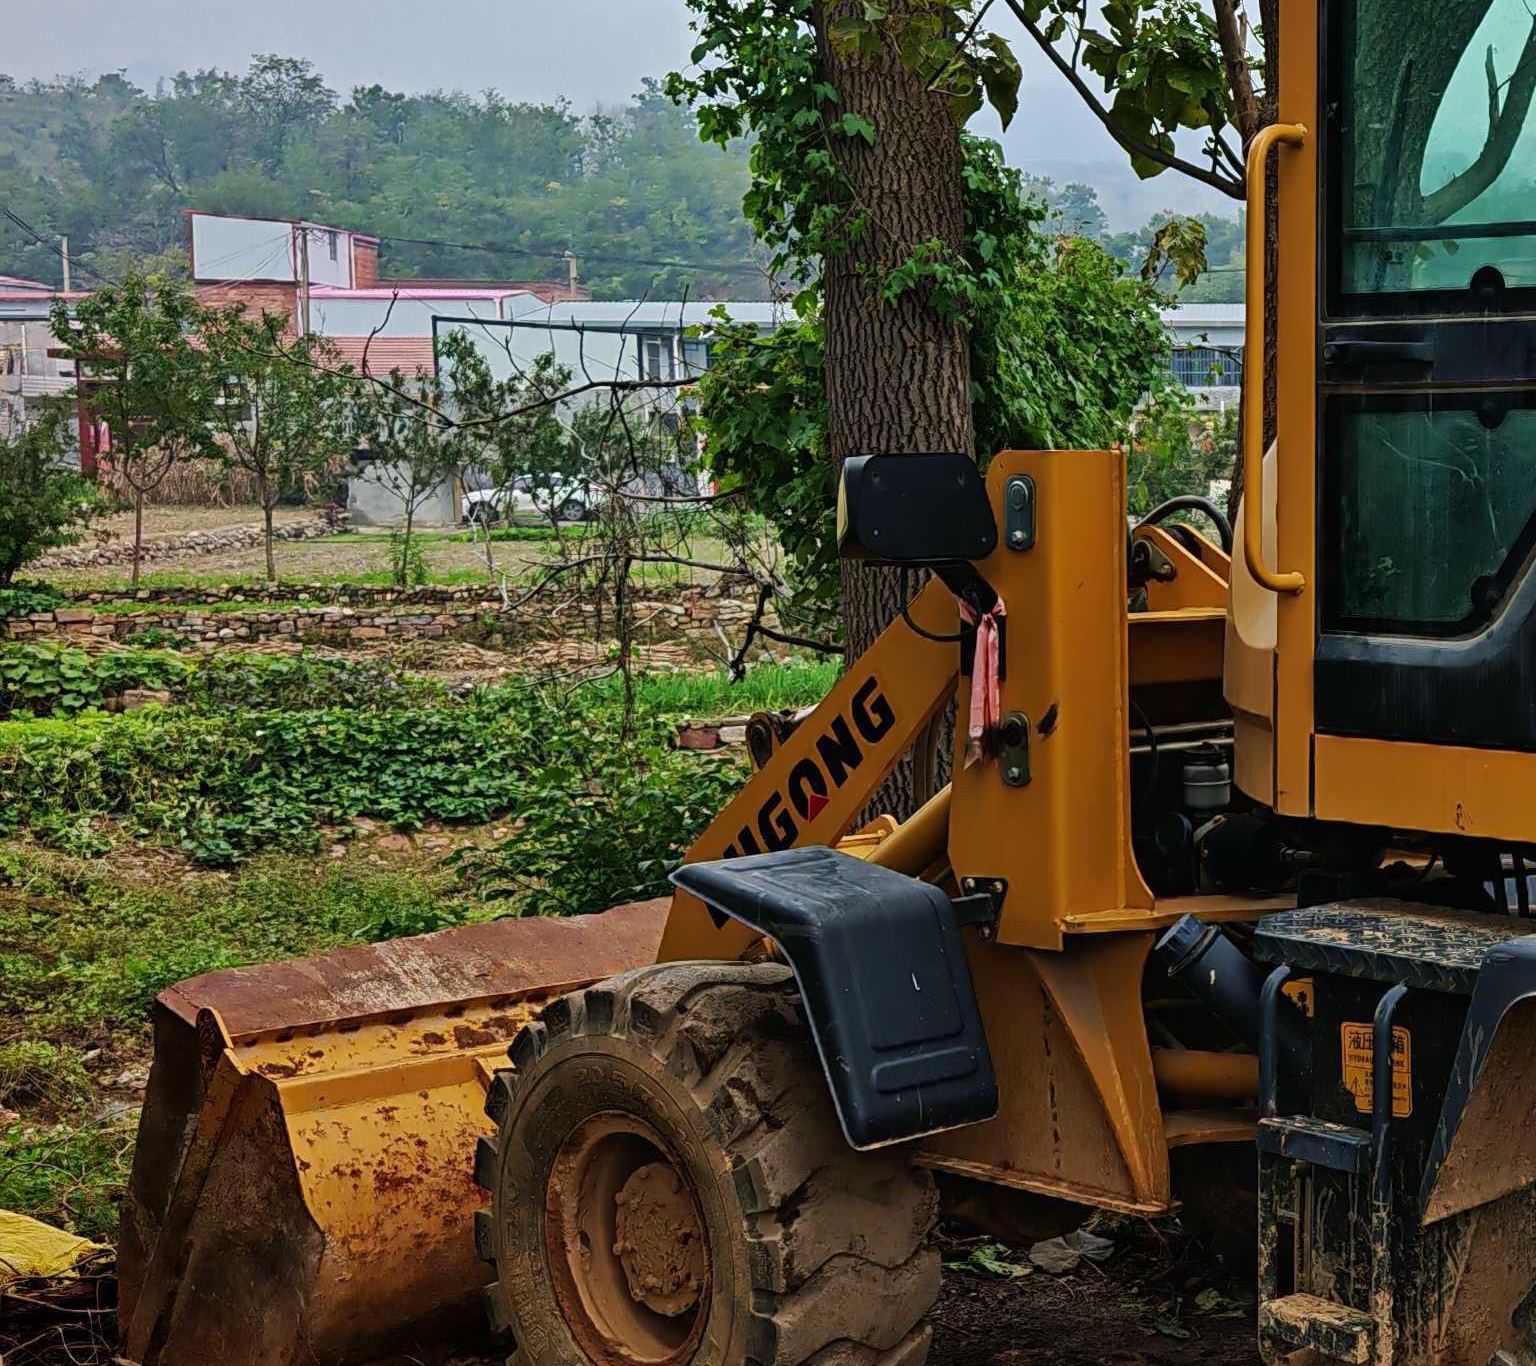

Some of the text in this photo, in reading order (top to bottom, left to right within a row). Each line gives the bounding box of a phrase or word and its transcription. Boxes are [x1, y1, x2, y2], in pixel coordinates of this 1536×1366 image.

[704, 675, 896, 929] GONG
[1348, 1030, 1406, 1054] 液压箱
